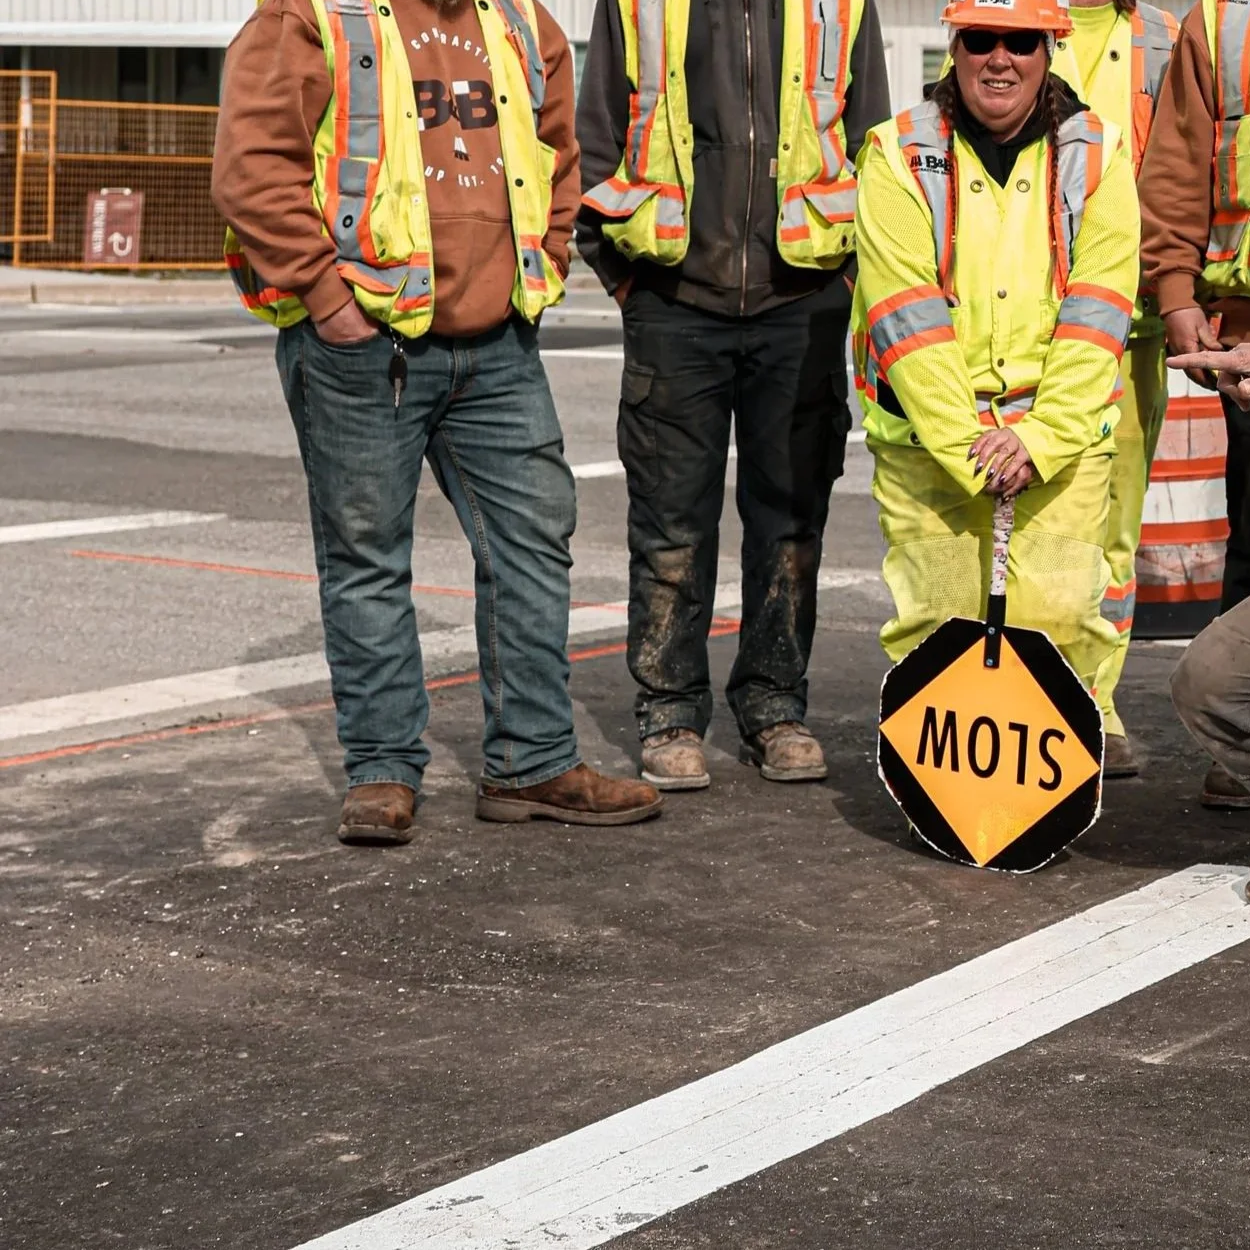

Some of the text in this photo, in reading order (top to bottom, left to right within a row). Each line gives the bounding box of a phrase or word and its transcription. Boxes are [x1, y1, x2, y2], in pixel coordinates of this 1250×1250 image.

[410, 27, 493, 71] CONRACTI
[413, 79, 498, 131] BB
[916, 705, 1066, 791] SLOW
